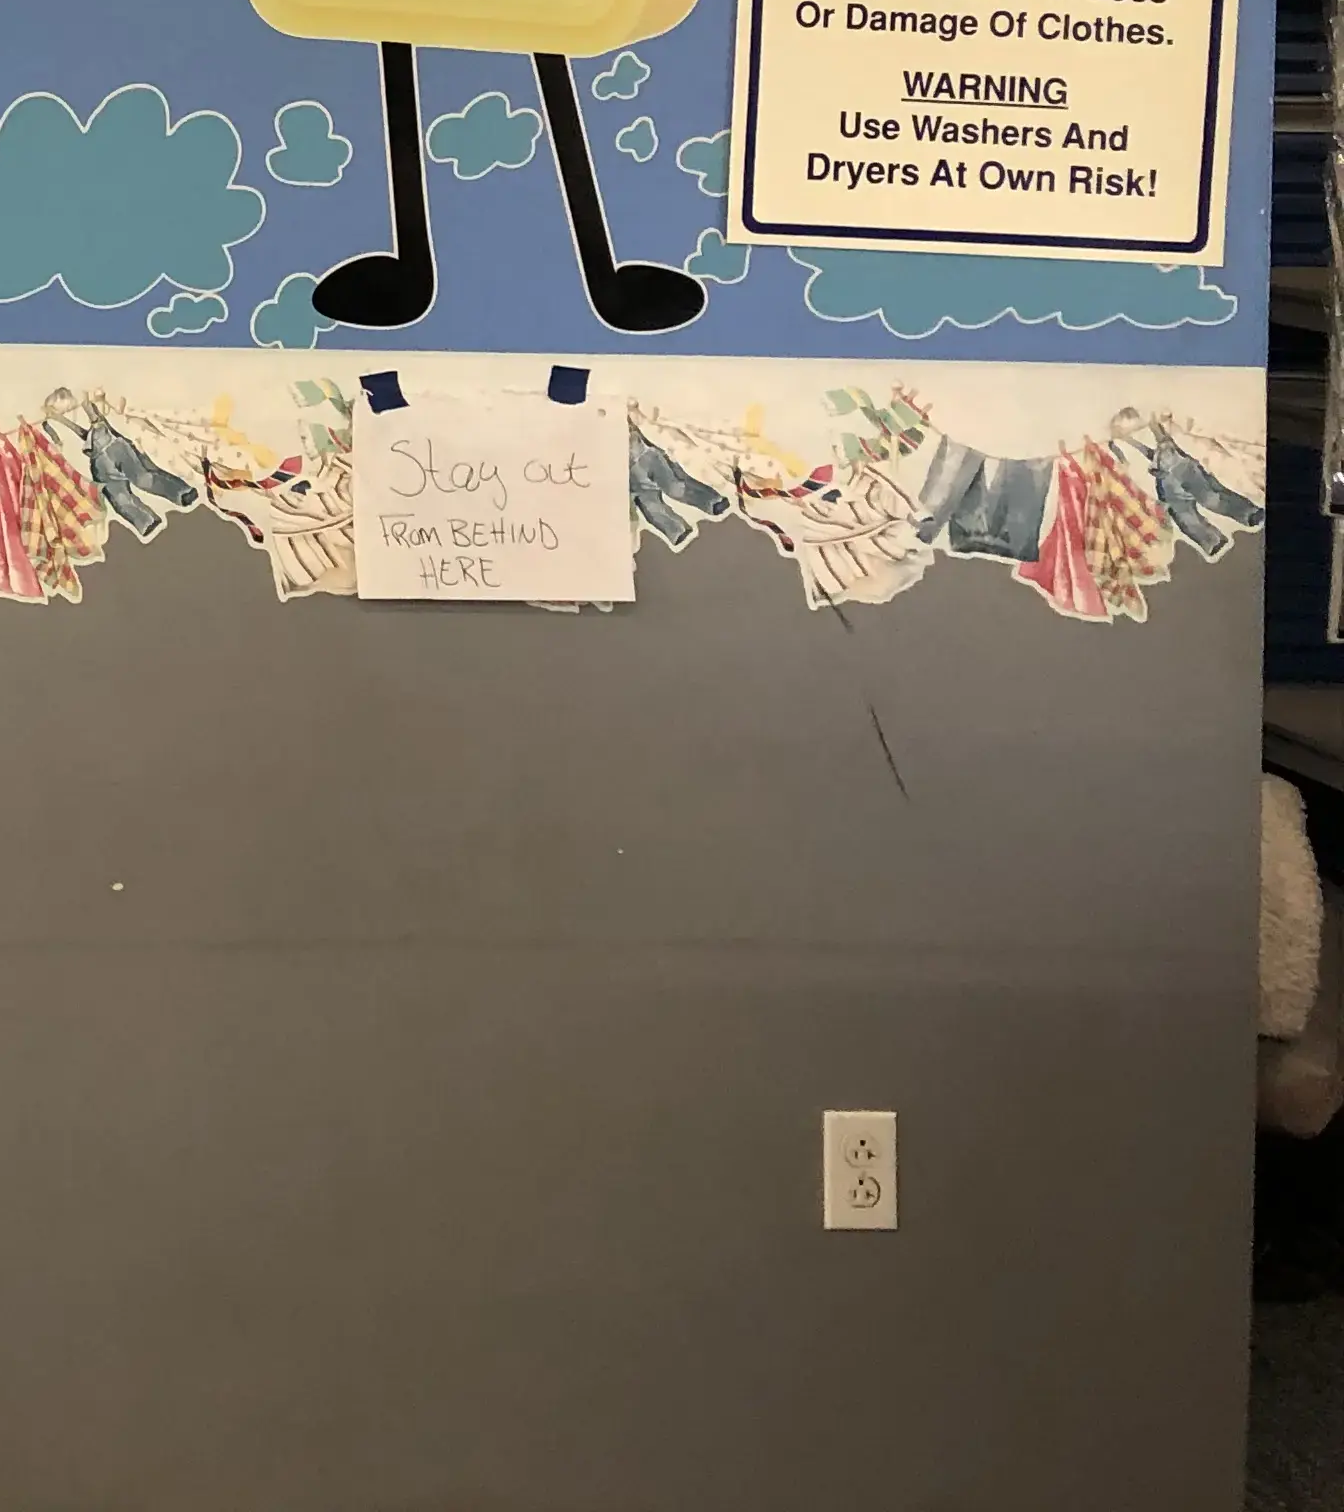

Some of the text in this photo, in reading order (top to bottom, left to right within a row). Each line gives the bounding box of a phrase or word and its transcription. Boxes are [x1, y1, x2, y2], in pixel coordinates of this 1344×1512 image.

[795, 0, 1174, 46] Or Damage Of Clothes.
[901, 71, 1069, 106] WARNING
[839, 112, 1128, 152] Use Washers And
[806, 153, 1158, 198] Dryers At Own Risk!
[389, 438, 591, 511] Stay out
[447, 517, 559, 551] BEHIND
[419, 555, 501, 590] HERE
